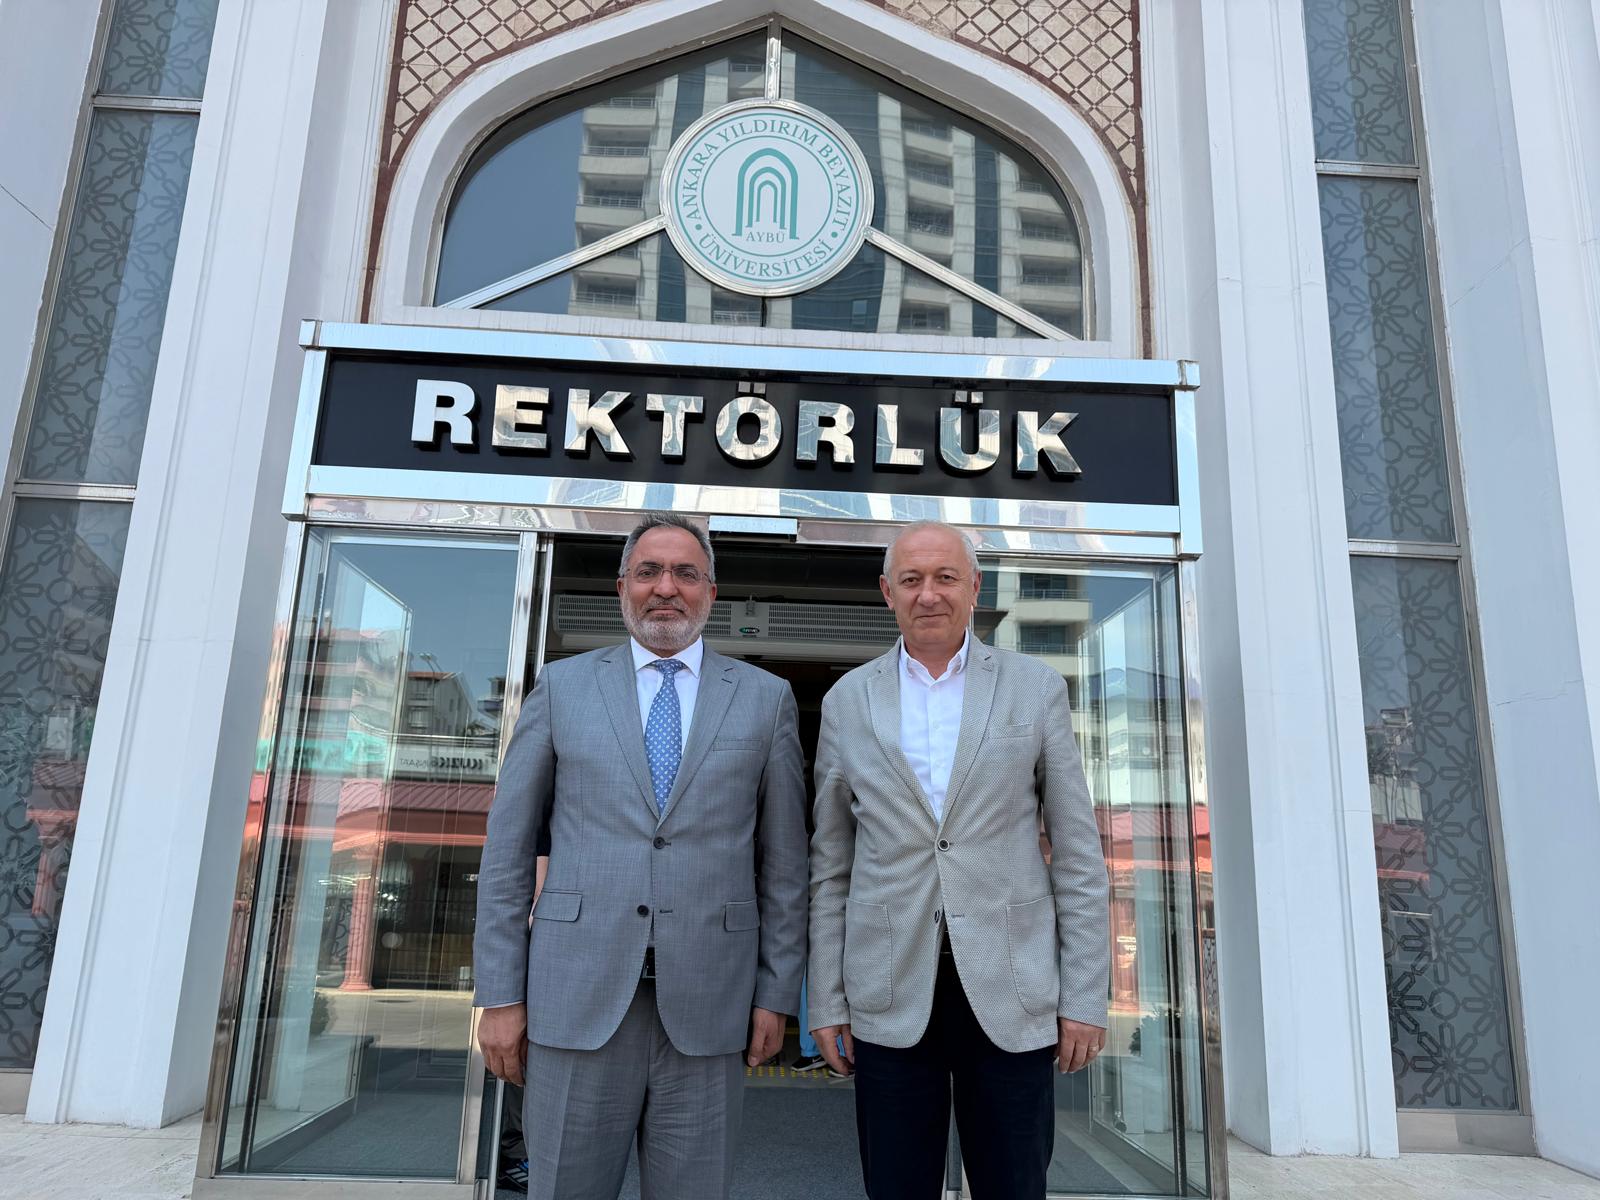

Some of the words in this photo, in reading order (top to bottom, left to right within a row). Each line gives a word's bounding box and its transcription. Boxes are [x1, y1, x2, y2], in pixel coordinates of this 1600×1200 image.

[682, 142, 718, 220] ANKARA
[716, 119, 820, 147] YILDIRIM
[818, 143, 853, 232] BEYAZIT
[698, 233, 834, 277] ÜNİVERSİTESİ
[745, 231, 785, 244] AYBÜ
[411, 379, 1080, 474] REKTÖRLÜK
